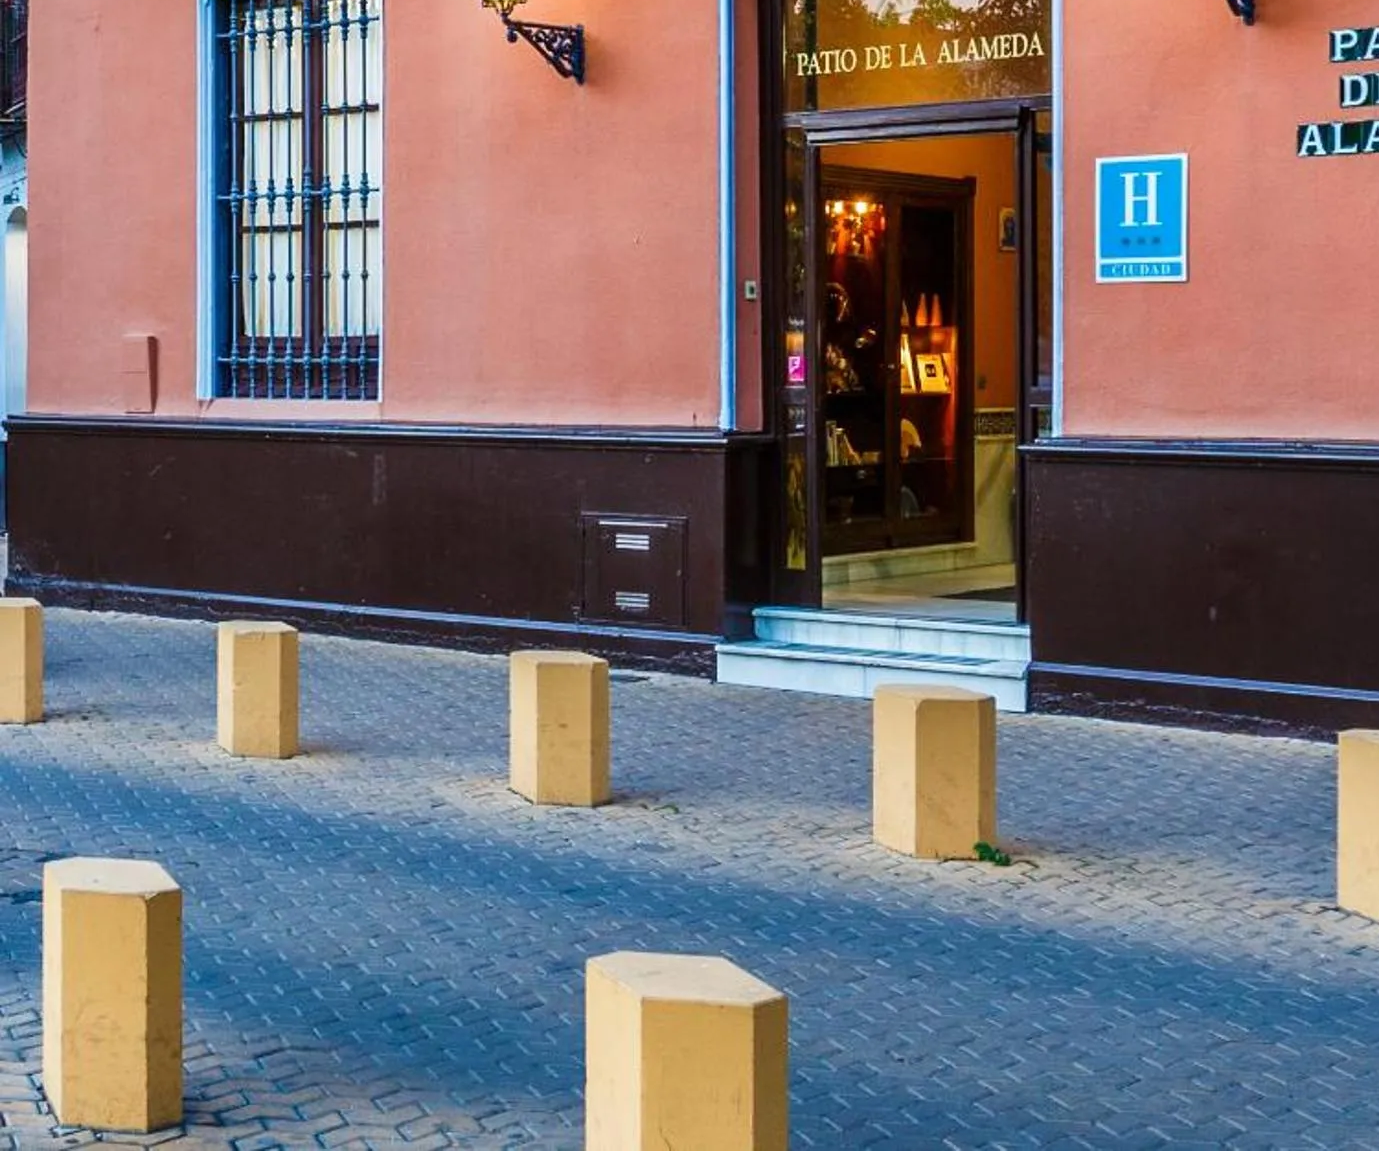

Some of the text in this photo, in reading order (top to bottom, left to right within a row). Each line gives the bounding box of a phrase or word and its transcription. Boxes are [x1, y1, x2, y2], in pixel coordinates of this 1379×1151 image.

[797, 32, 1045, 76] PATIO DE LA ALAMEDA
[1119, 171, 1163, 227] H
